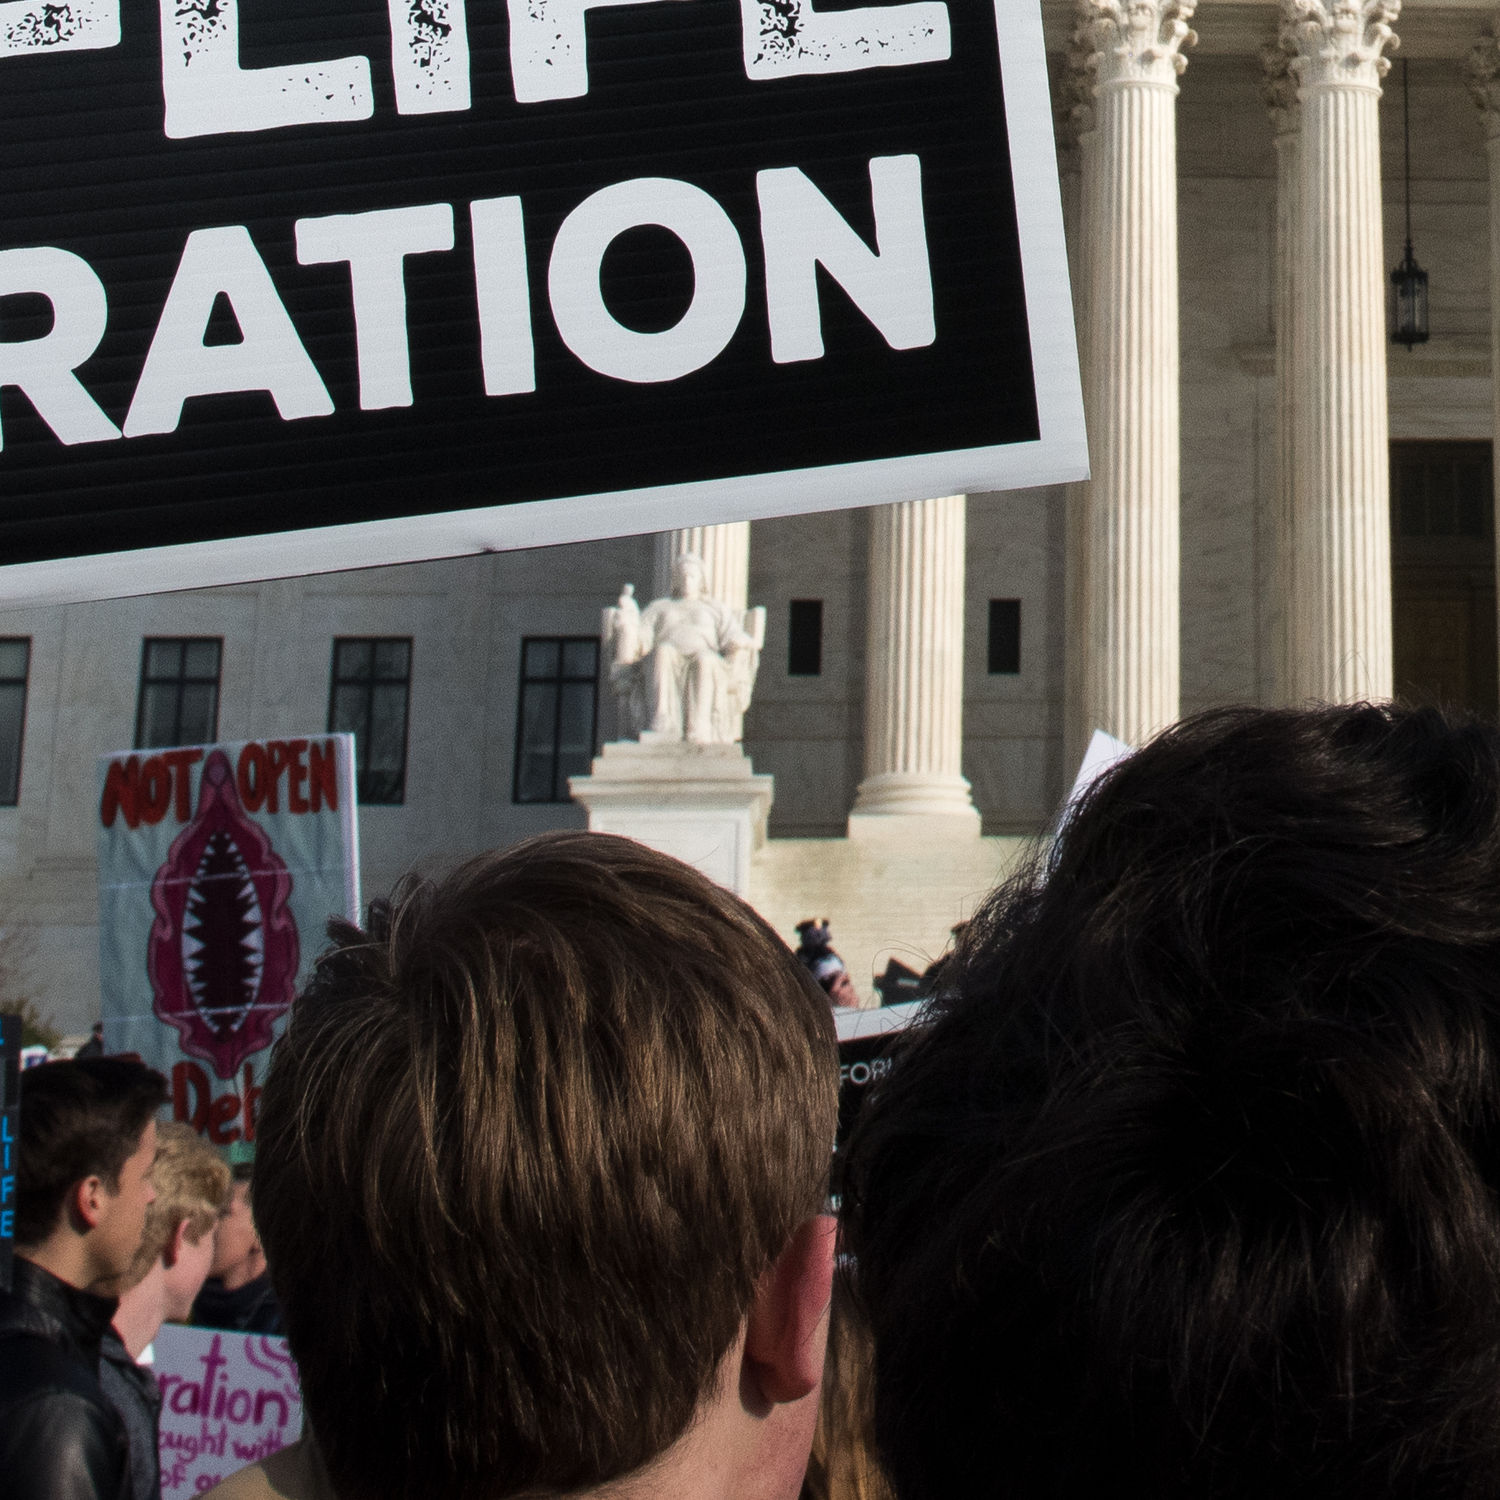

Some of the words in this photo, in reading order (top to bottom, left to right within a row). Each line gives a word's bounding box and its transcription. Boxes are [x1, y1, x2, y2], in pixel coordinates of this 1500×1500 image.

[102, 749, 203, 829] NOT
[238, 739, 339, 815] OPEN
[0, 1115, 16, 1239] LIFE
